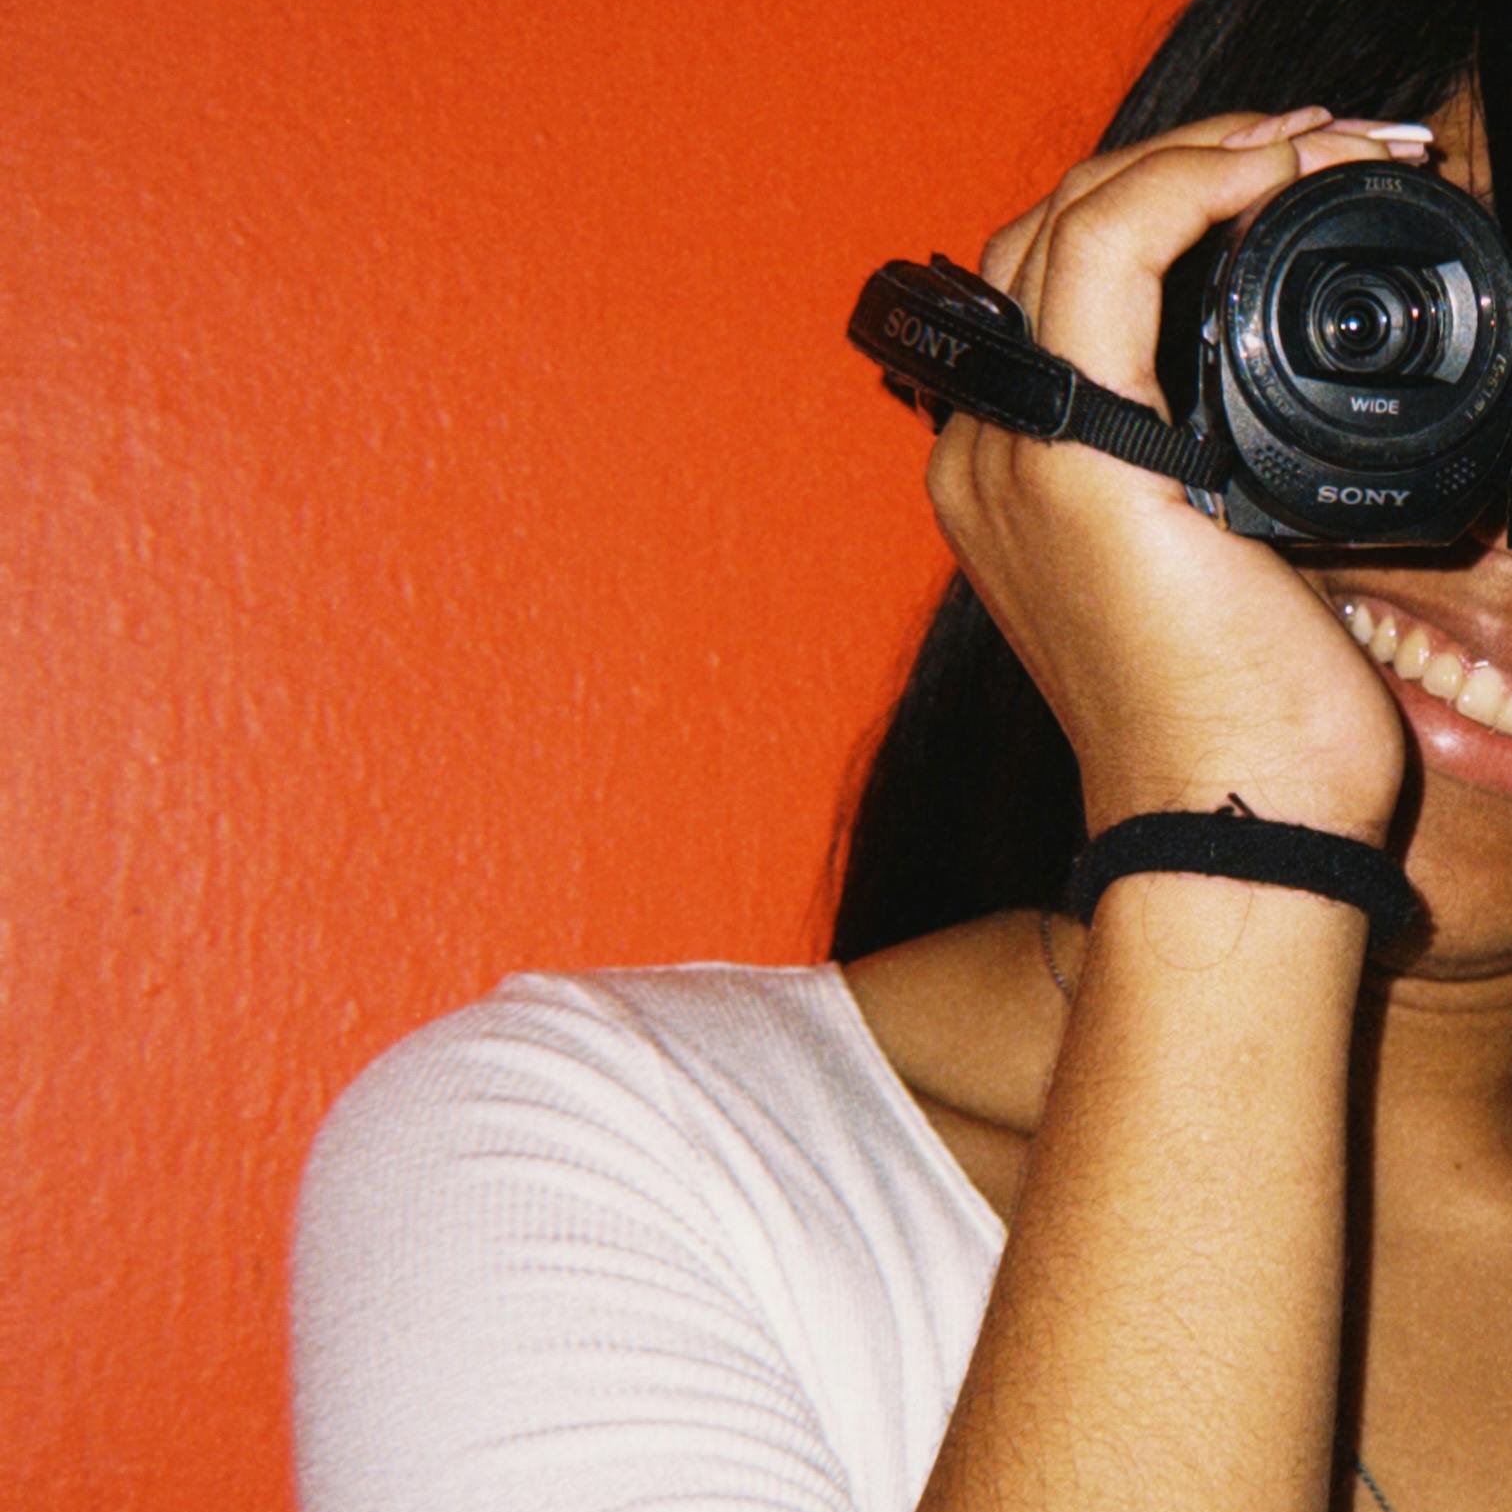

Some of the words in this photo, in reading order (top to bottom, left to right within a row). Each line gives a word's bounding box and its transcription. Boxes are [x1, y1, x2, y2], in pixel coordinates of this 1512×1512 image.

[1363, 175, 1403, 193] ZEISS
[884, 307, 971, 368] SONY
[1350, 396, 1400, 416] WIDE
[1317, 485, 1411, 507] SONY
